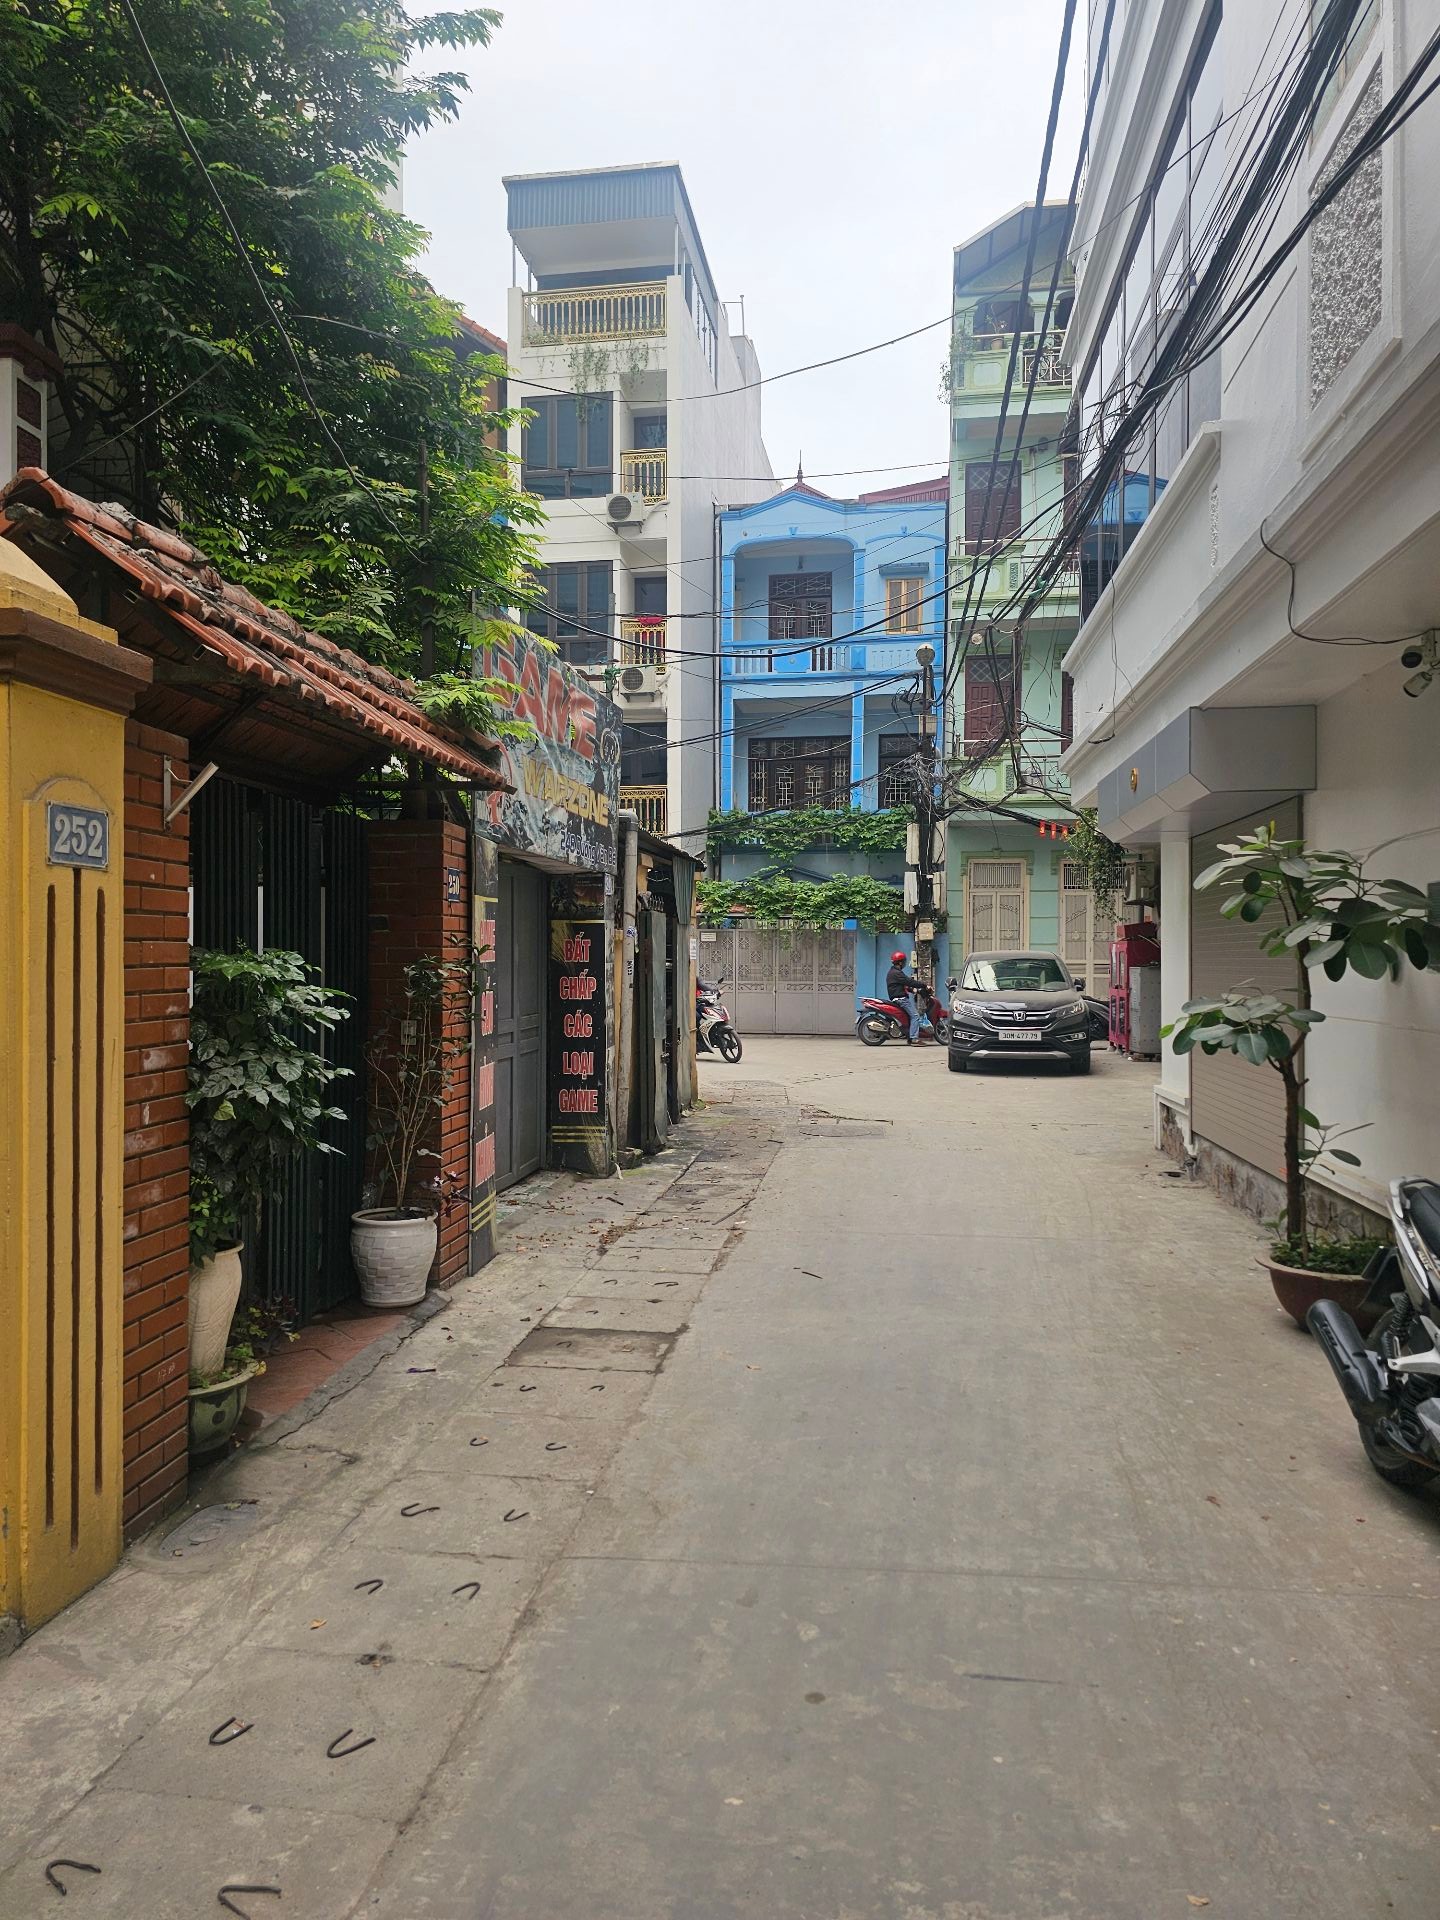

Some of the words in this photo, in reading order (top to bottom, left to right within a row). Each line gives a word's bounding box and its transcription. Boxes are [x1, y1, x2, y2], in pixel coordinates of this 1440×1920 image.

[521, 754, 609, 828] WARZONE
[54, 813, 103, 858] 252
[448, 874, 460, 895] 250
[563, 931, 592, 963] BẤT
[559, 968, 598, 1000] CHẤP
[563, 1009, 593, 1038] CÁC
[562, 1051, 594, 1080] LOẠI
[558, 1089, 599, 1113] GAME
